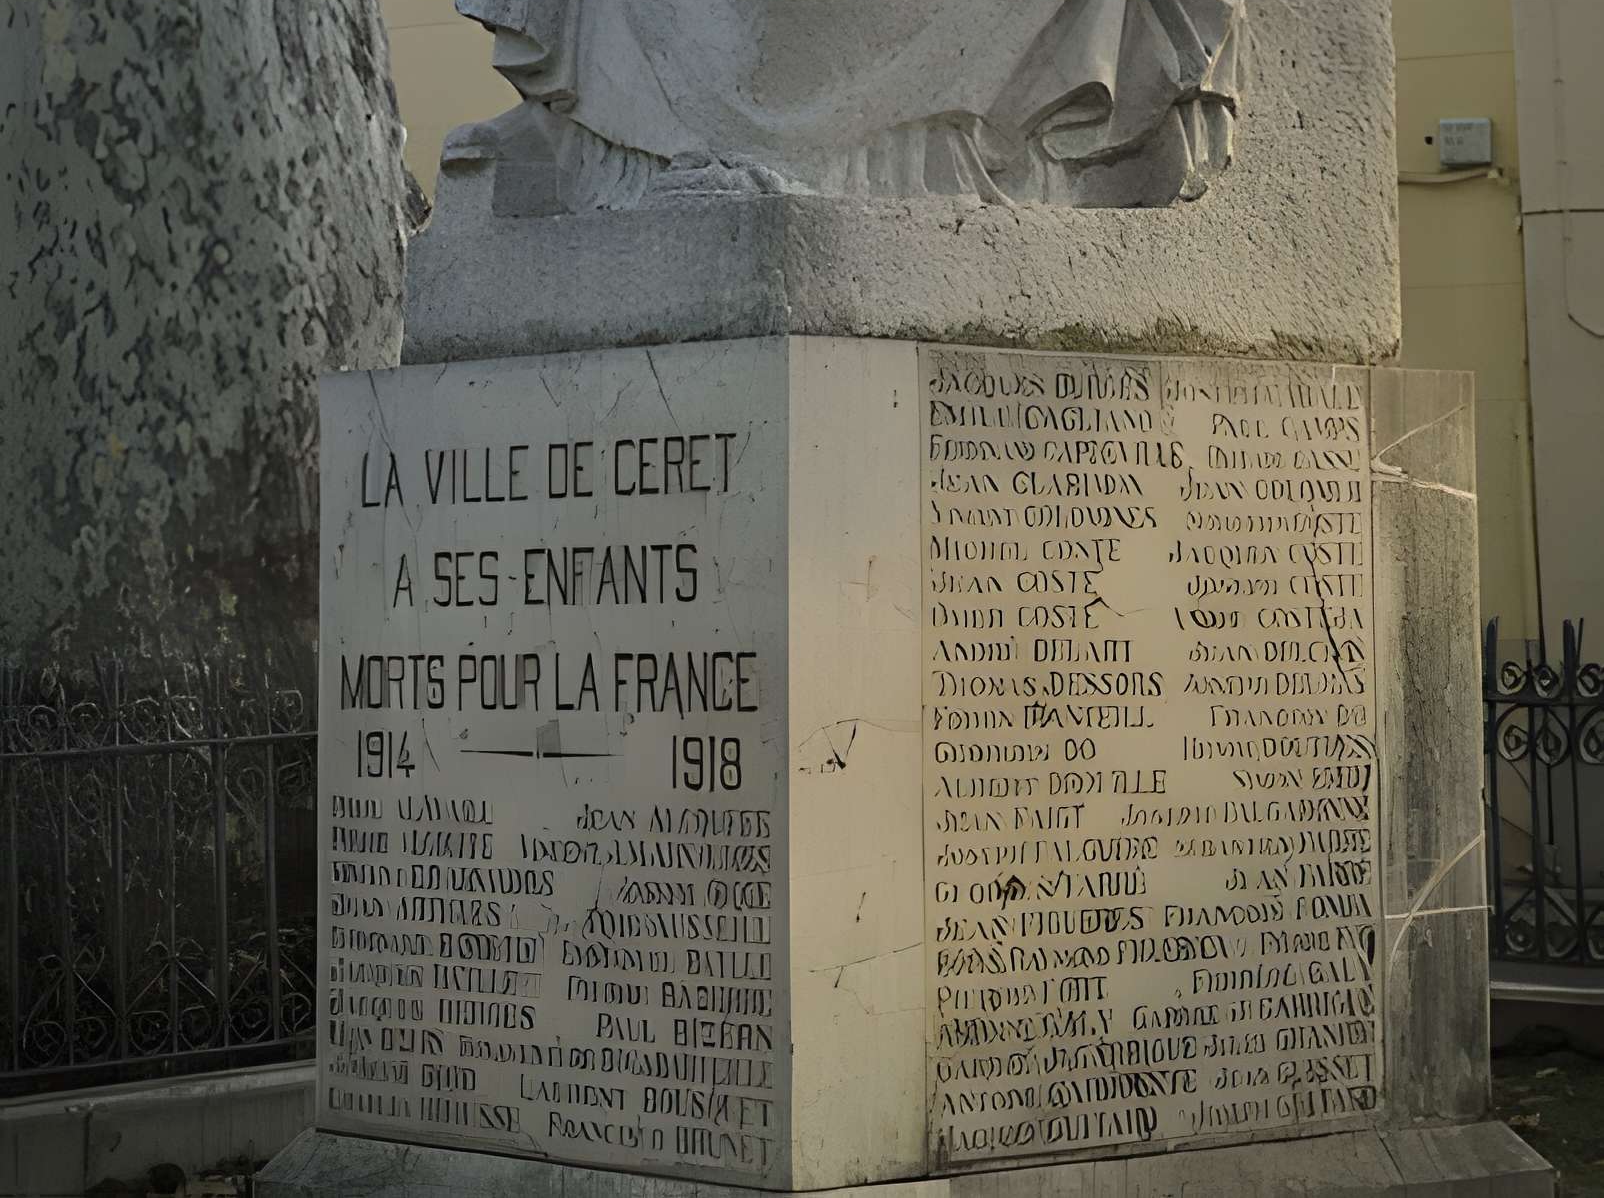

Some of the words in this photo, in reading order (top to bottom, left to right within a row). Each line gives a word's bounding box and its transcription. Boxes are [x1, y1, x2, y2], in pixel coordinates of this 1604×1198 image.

[361, 450, 404, 508] LA
[425, 445, 529, 504] VILLE
[548, 441, 594, 499] DE
[614, 433, 737, 496] CERET
[393, 553, 414, 608] A
[433, 551, 499, 607] SES
[523, 543, 698, 606] ENFANTS
[341, 653, 445, 710] MORTS
[458, 653, 541, 711] POUR
[555, 653, 600, 712] LA
[614, 651, 758, 714] FRANCE
[357, 729, 416, 778] 1914
[671, 734, 742, 792] 1918
